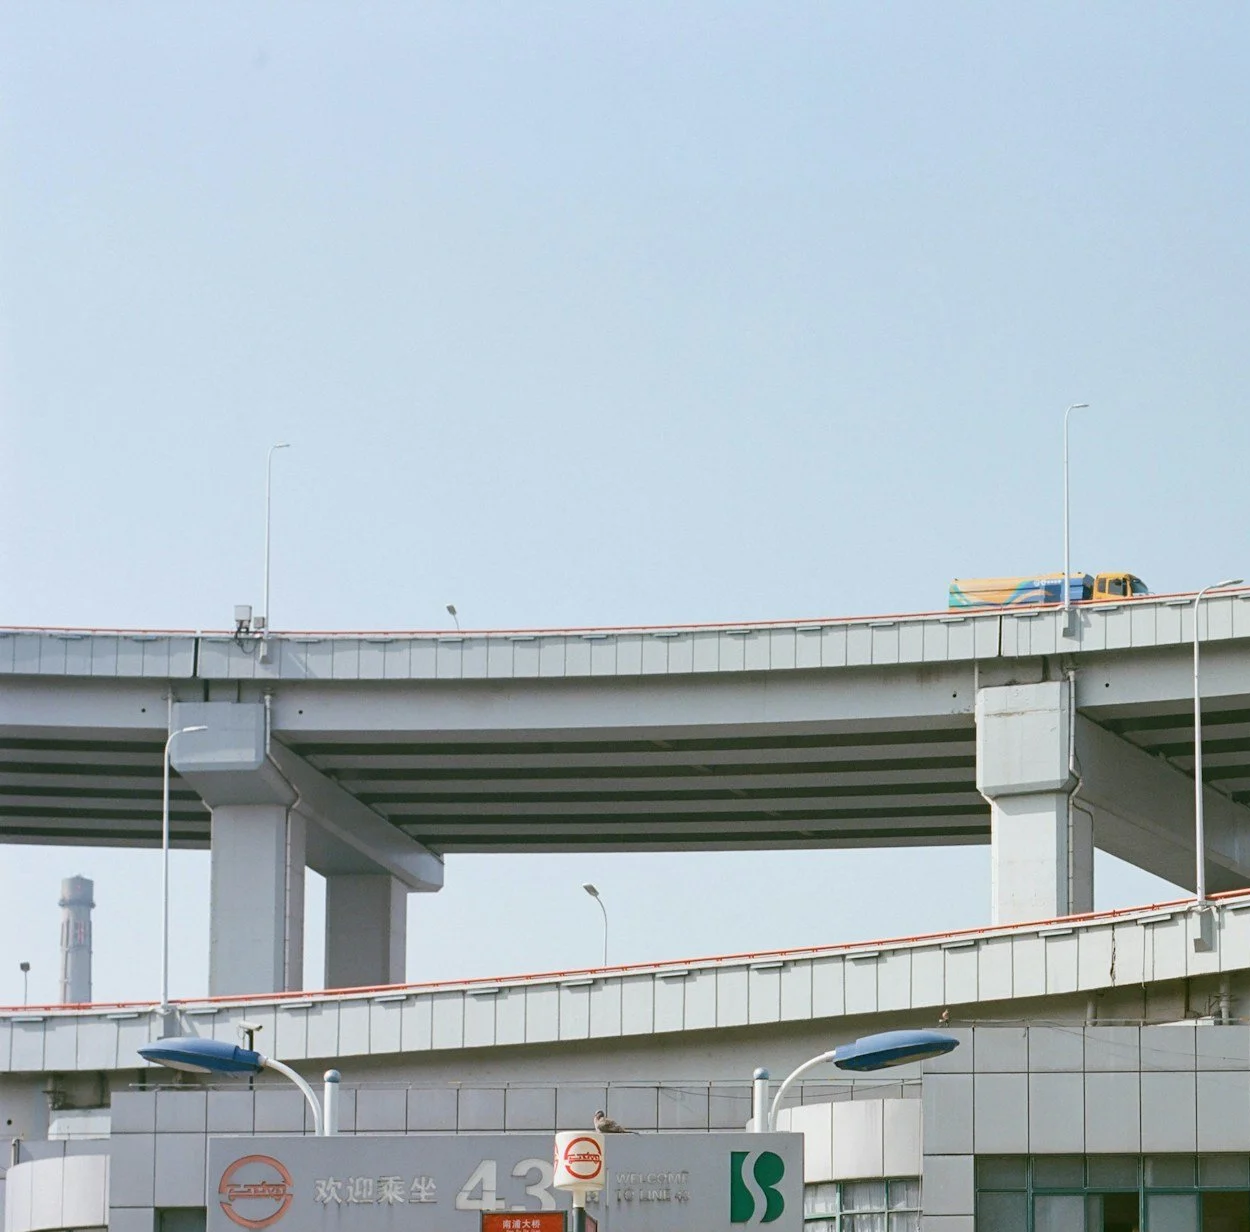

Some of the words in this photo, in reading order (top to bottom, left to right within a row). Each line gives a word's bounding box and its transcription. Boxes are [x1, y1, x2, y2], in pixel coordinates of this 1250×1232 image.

[616, 1171, 690, 1184] WELCOME
[314, 1176, 438, 1204] 欢迎乘坐
[616, 1189, 635, 1202] TO
[638, 1189, 672, 1202] LINE
[502, 1219, 540, 1229] 南浦大桥
